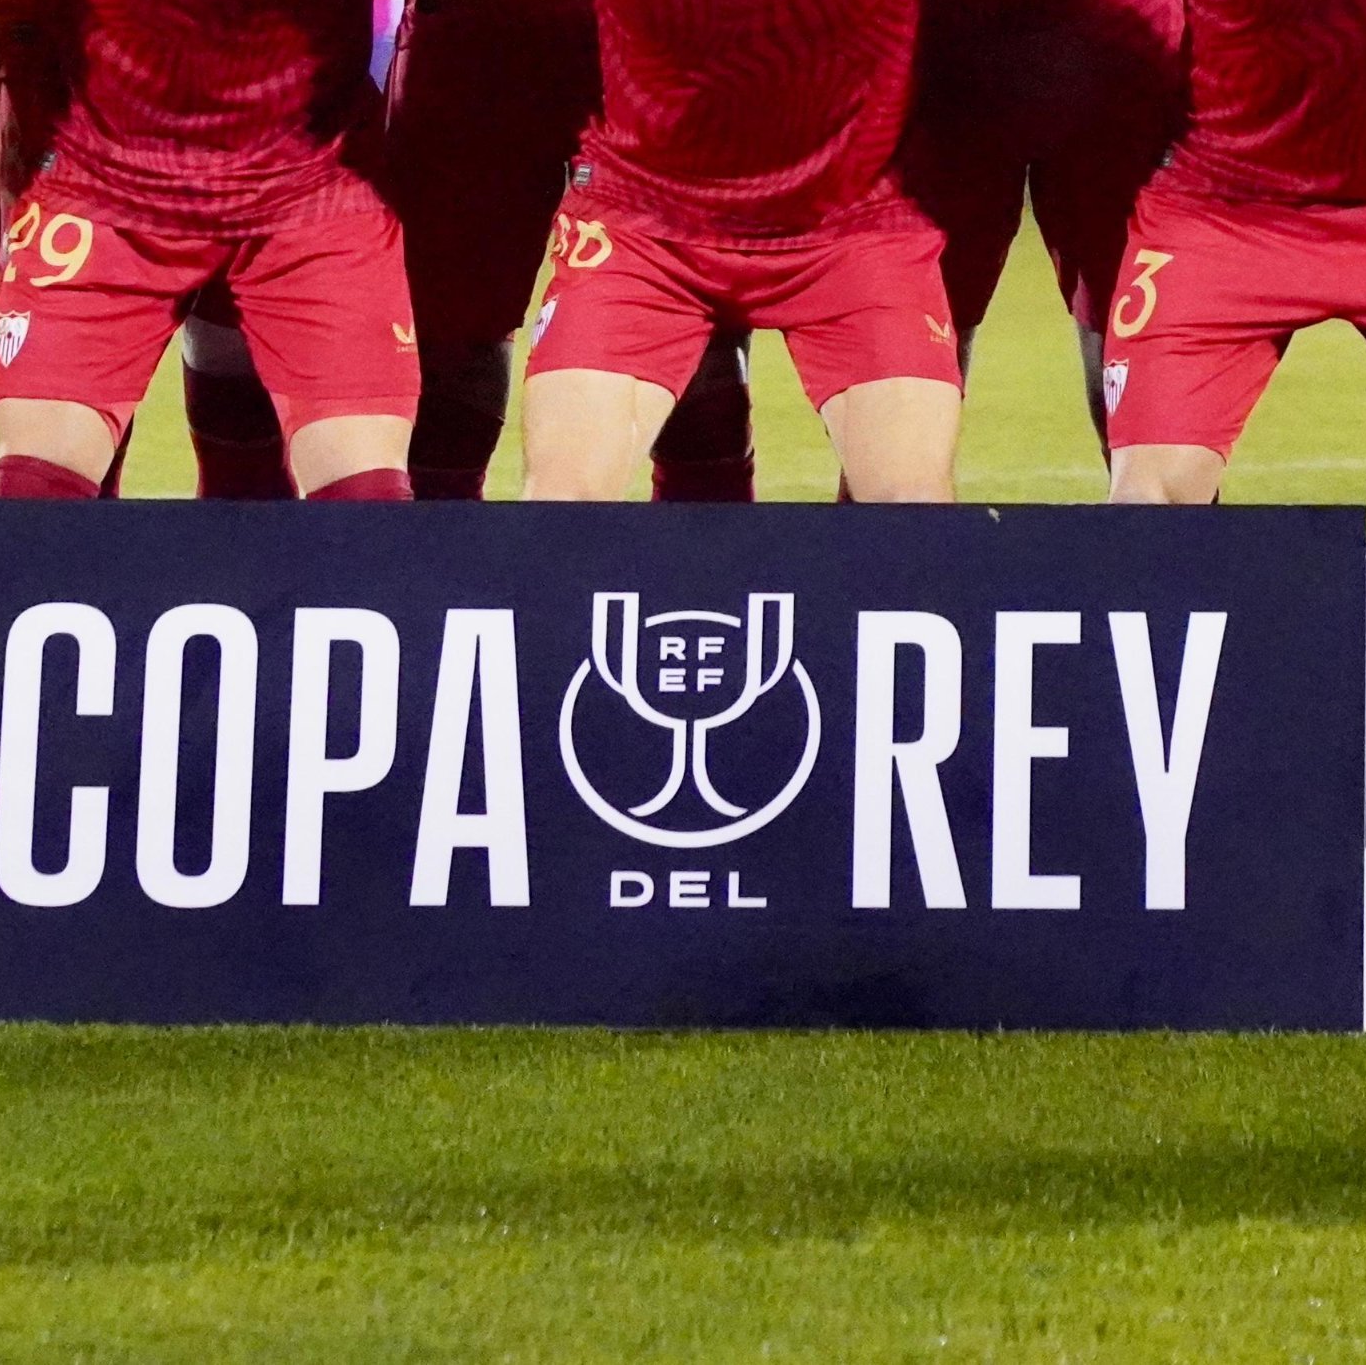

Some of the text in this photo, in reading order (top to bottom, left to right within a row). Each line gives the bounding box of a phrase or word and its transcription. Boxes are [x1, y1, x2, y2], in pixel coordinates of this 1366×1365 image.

[2, 201, 94, 288] 29
[1113, 248, 1174, 338] 3
[851, 609, 1229, 910] REY
[609, 870, 768, 909] DEL
